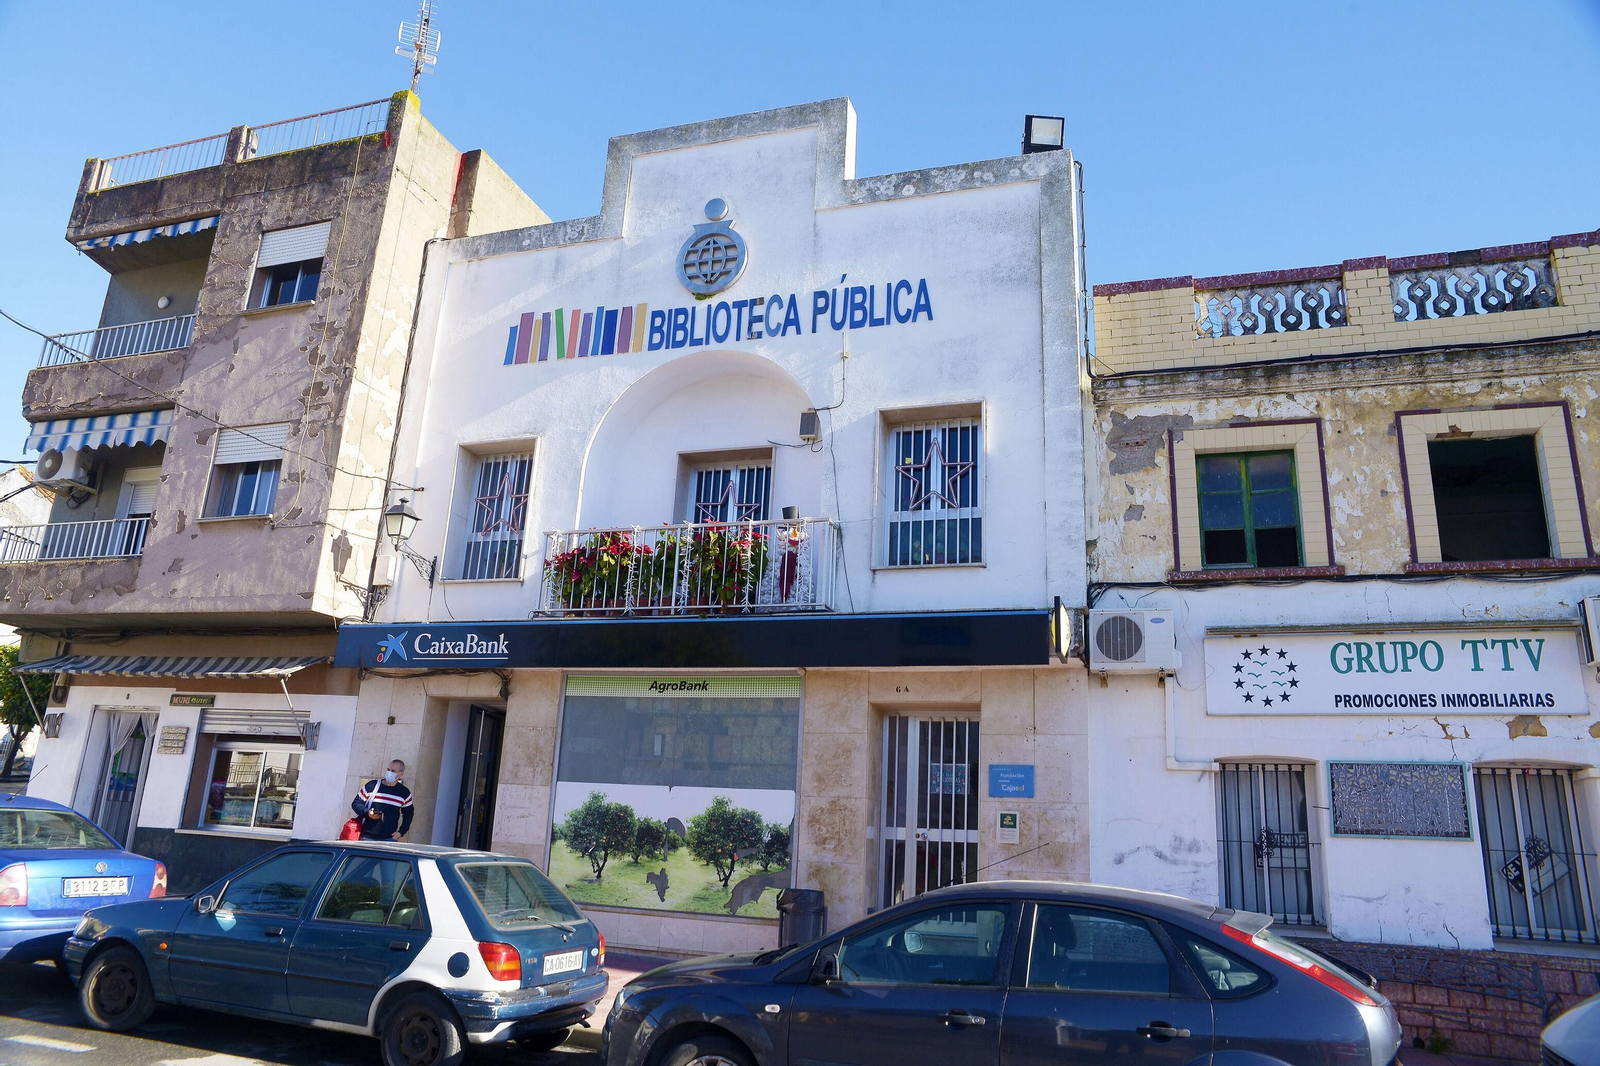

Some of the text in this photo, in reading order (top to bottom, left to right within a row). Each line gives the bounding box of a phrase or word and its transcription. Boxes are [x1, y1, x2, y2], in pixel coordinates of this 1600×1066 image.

[647, 273, 934, 352] BIBLIOTECA PÚBLICA
[414, 633, 509, 654] CaixaBank
[1330, 638, 1545, 674] GRUPO TTV
[649, 681, 709, 693] AgroBank
[1334, 692, 1555, 708] PROMOCIONES INMOBILIARIAS
[1001, 784, 1025, 792] Cajasol
[73, 880, 125, 892] 3112 BFP
